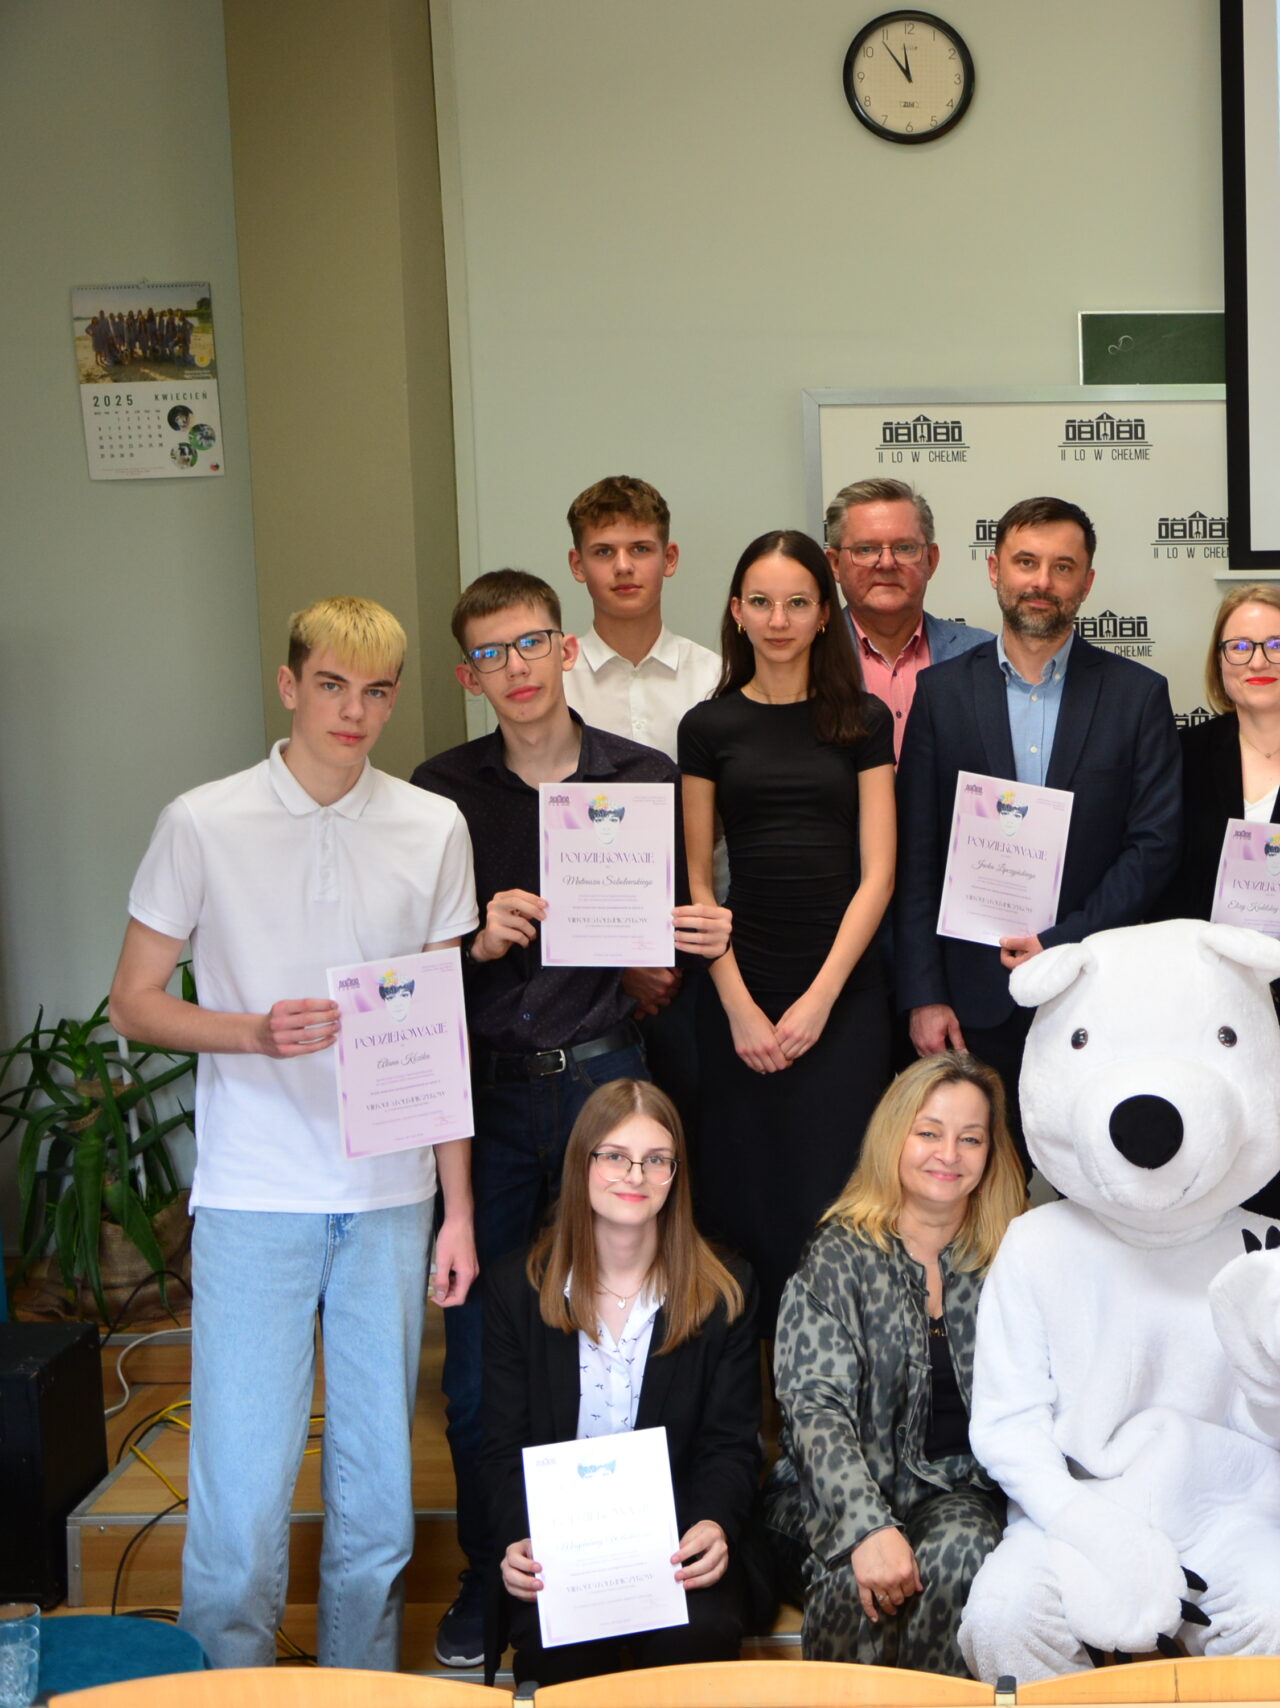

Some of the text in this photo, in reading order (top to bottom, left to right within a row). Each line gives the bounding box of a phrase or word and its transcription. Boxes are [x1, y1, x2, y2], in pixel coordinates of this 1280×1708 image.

[881, 28, 889, 41] 11
[904, 22, 915, 35] 12
[862, 46, 874, 58] 10
[948, 48, 957, 60] 2
[856, 71, 866, 83] 9
[953, 73, 962, 85] 3
[863, 95, 872, 107] 8
[946, 98, 954, 109] 4
[881, 114, 889, 126] 7
[929, 115, 938, 128] 5
[905, 121, 914, 133] 6
[93, 393, 133, 407] 2025
[878, 449, 967, 463] II LO W CHEŁMIE
[1060, 447, 1150, 461] II LO W CHEŁMIE
[1153, 546, 1229, 559] II LO W CHEŁ
